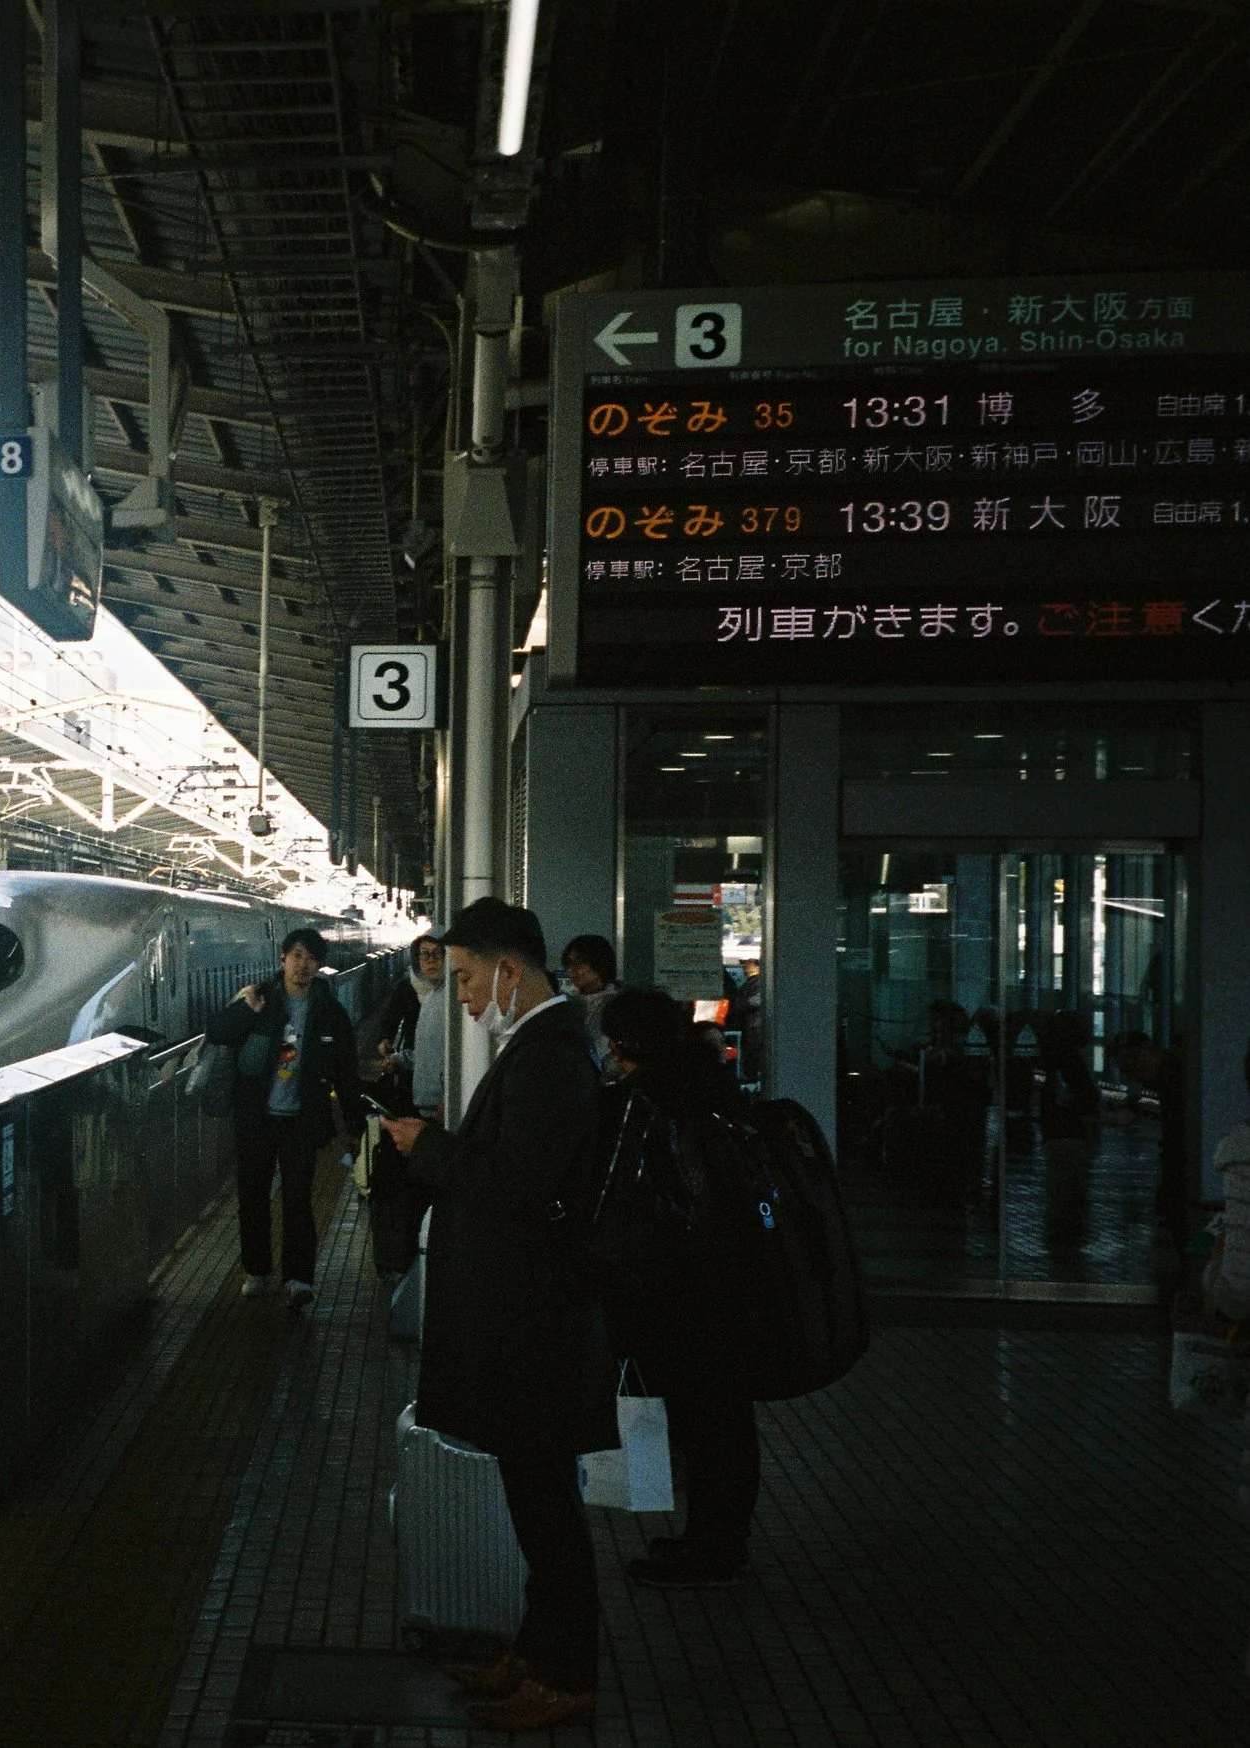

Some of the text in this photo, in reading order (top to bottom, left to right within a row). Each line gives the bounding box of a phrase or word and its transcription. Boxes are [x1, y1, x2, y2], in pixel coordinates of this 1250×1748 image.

[689, 311, 727, 360] 3
[843, 336, 883, 358] for
[1019, 323, 1186, 352] Shin-Ōsaka
[588, 401, 727, 436] のぞみ
[754, 402, 794, 429] 35
[843, 395, 950, 429] 13:31
[1156, 393, 1226, 417] 自由席
[1, 440, 23, 475] 8
[585, 504, 725, 539] のぞみ
[740, 506, 802, 533] 379
[839, 500, 951, 533] 13:39
[973, 494, 1121, 531] 新大阪
[1153, 501, 1223, 524] 自由席
[372, 660, 411, 712] 3
